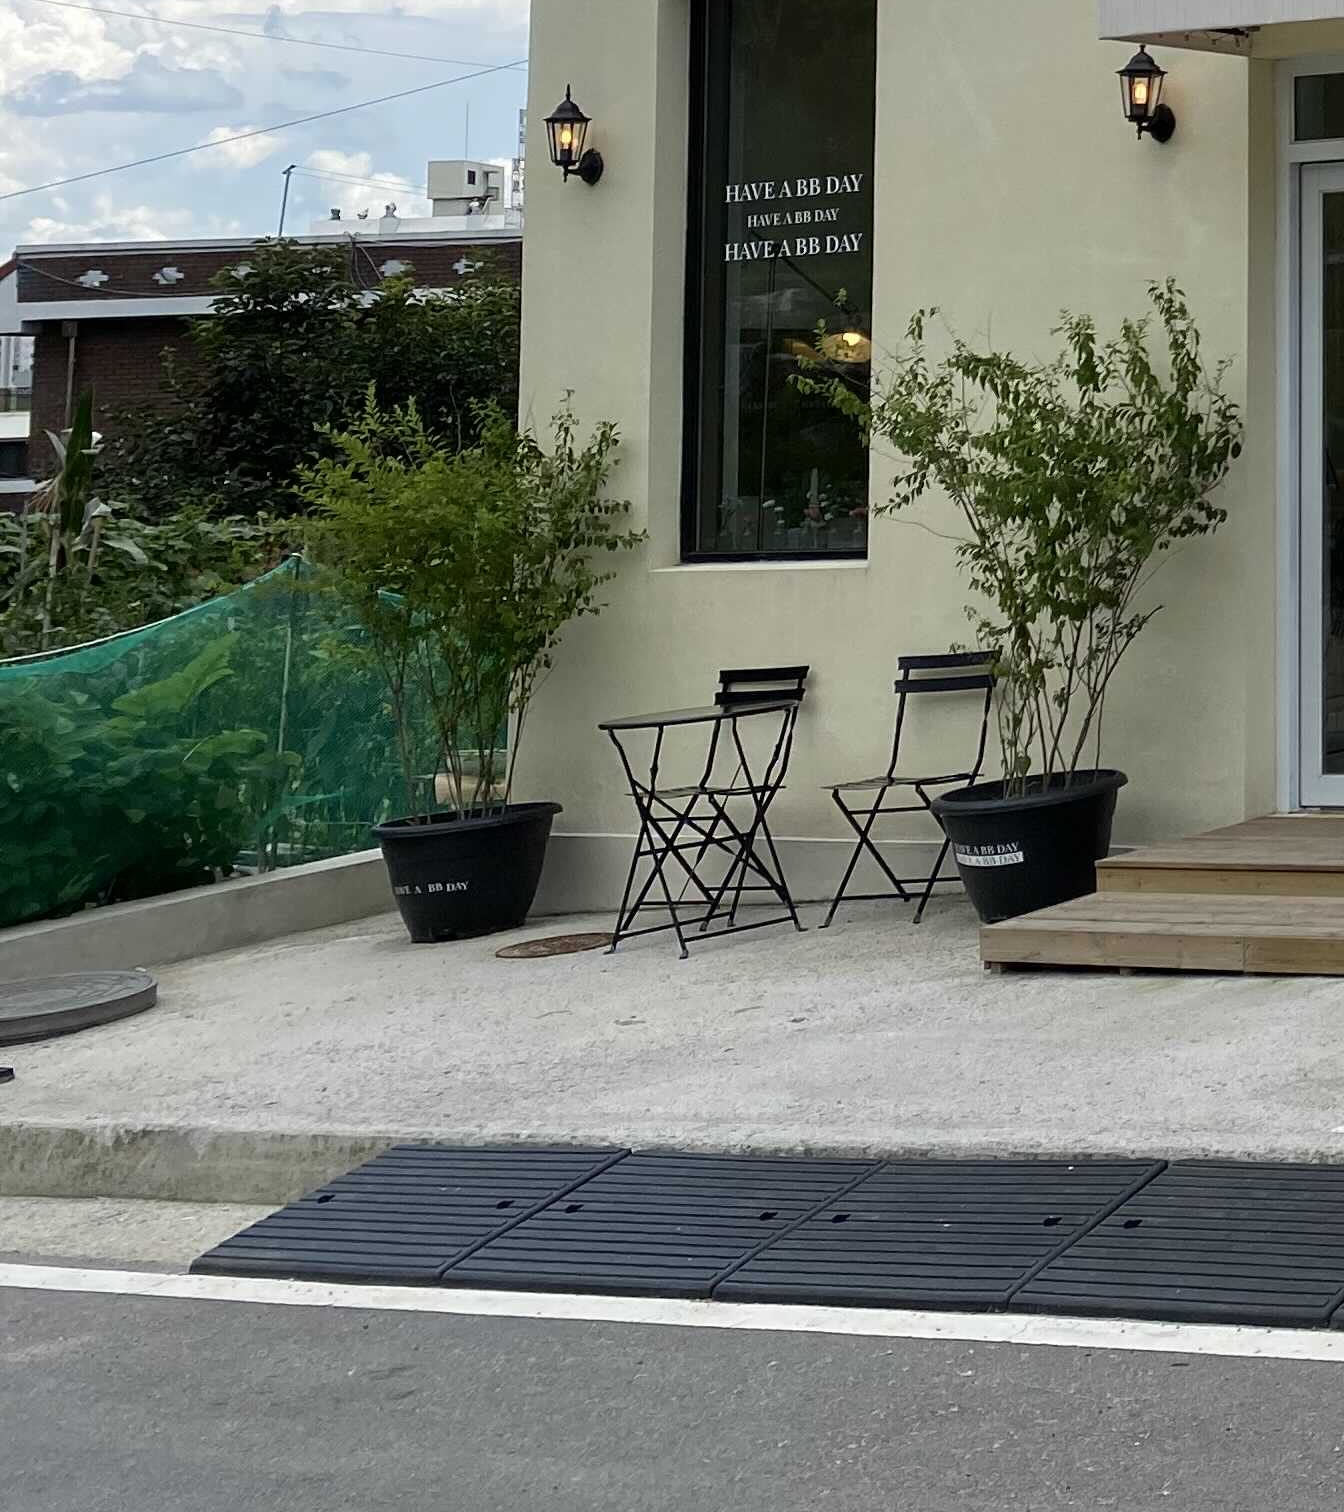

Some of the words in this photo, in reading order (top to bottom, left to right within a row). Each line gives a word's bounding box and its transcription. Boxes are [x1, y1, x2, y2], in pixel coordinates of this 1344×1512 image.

[724, 181, 775, 203] HAVE
[778, 180, 792, 199] A
[796, 177, 821, 197] BB
[826, 174, 863, 194] DAY
[747, 212, 781, 228] HAVE
[782, 211, 792, 225] A
[795, 209, 812, 224] BB
[815, 207, 840, 223] DAY
[724, 240, 775, 262] HAVE
[778, 239, 791, 258] A
[795, 237, 820, 257] BB
[825, 233, 863, 254] DAY
[997, 841, 1019, 854] DAY
[446, 881, 469, 892] DAY
